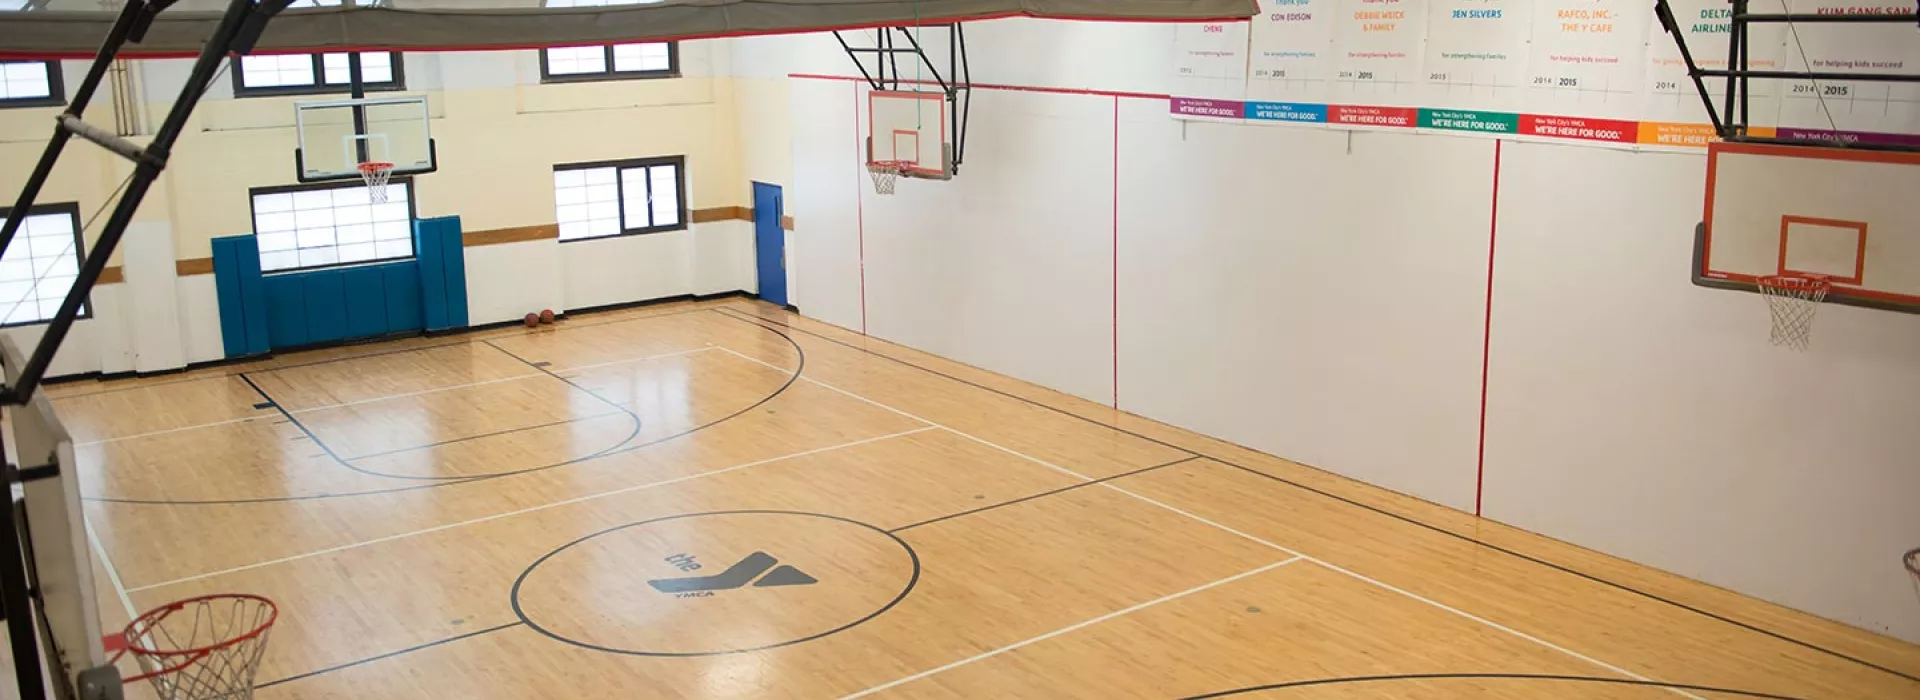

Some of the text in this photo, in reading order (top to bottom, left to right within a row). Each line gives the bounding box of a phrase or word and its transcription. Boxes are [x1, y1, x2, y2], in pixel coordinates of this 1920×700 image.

[1452, 9, 1502, 19] JEN SILVERS
[1557, 10, 1590, 19] RAFCO,
[1592, 10, 1611, 19] INC.
[1700, 9, 1732, 18] DELTA
[1848, 7, 1882, 15] GANG
[1885, 7, 1911, 15] SAN
[1286, 13, 1311, 21] EDISON
[1561, 24, 1613, 32] THE Y CAFE
[1691, 24, 1732, 33] AIRLINE
[1560, 56, 1580, 64] helping
[1825, 60, 1853, 69] helping
[1855, 60, 1870, 68] kids
[1559, 78, 1577, 86] 2015
[1793, 85, 1815, 93] 2014
[1824, 86, 1848, 96] 2015
[1340, 114, 1357, 122] WE'RE
[1432, 118, 1452, 127] WE'RE
[1454, 119, 1469, 128] HERE
[1470, 120, 1484, 129] FOR
[1535, 125, 1557, 135] WE'RE
[1558, 126, 1577, 136] HERE
[1579, 127, 1594, 137] FOR
[1657, 134, 1682, 143] WE'RE
[1684, 135, 1704, 143] HERE
[1842, 134, 1858, 142] MCA
[664, 553, 702, 572] the
